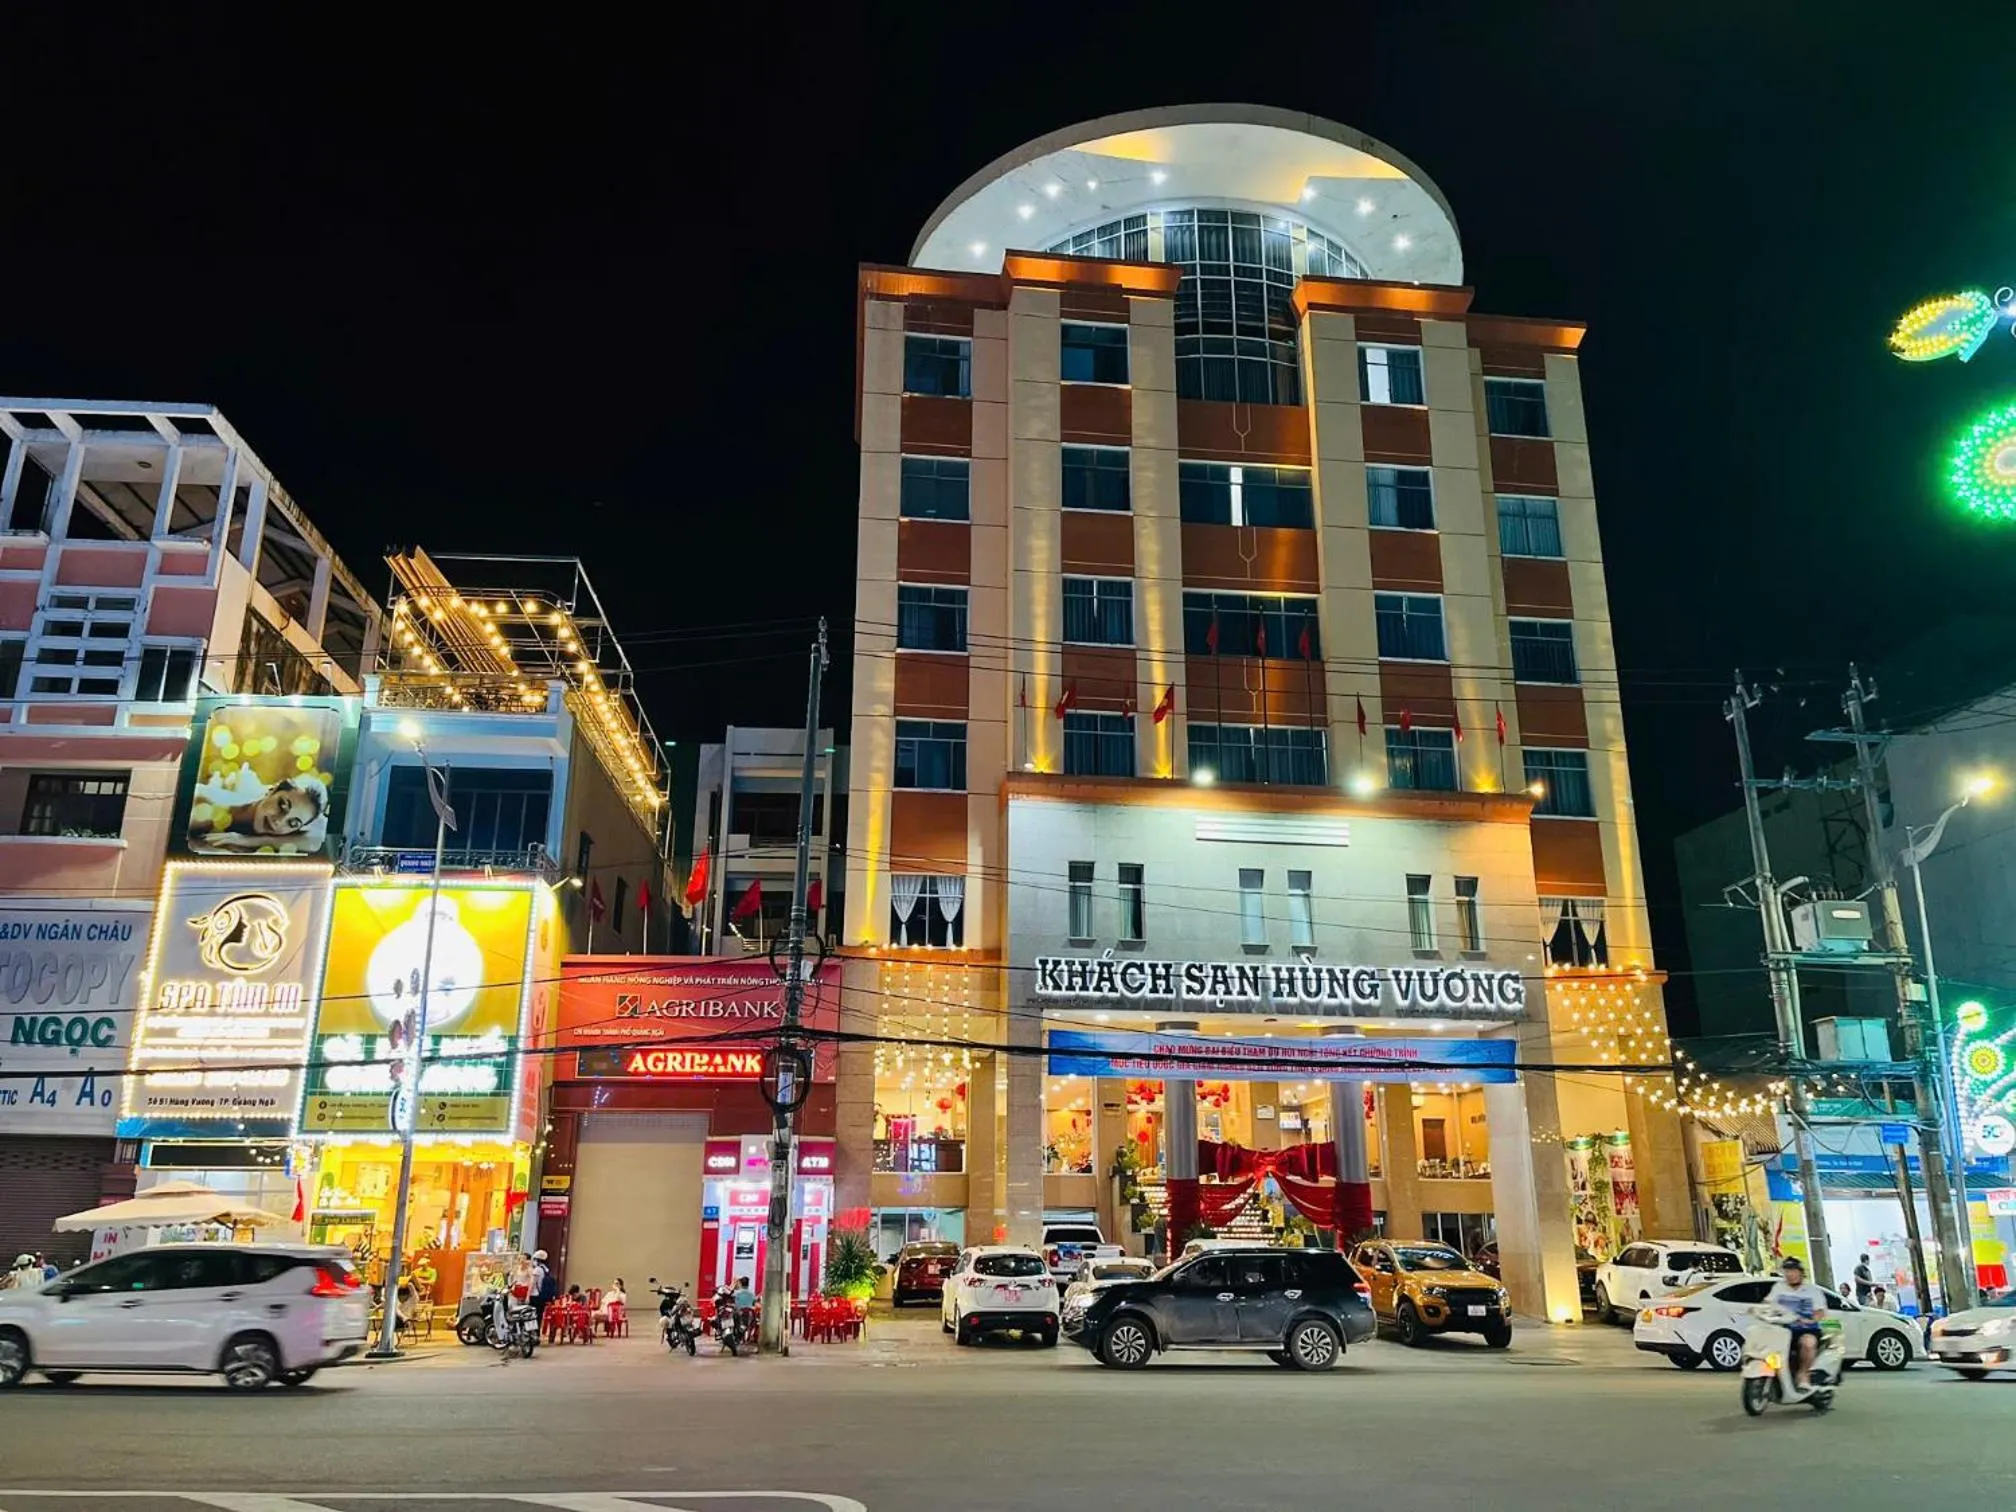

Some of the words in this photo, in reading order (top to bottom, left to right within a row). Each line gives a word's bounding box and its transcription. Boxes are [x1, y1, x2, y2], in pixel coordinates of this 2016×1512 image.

[1037, 949, 1174, 996] KHÁCH
[1183, 961, 1261, 1006] SẠN
[1271, 954, 1381, 1001] HÙNG
[1392, 967, 1525, 1005] VƯƠNG
[161, 982, 208, 1010] SPA
[645, 999, 781, 1018] AGRIBANK
[10, 1015, 117, 1056] NGỌC
[627, 1052, 763, 1073] AGRIBANK
